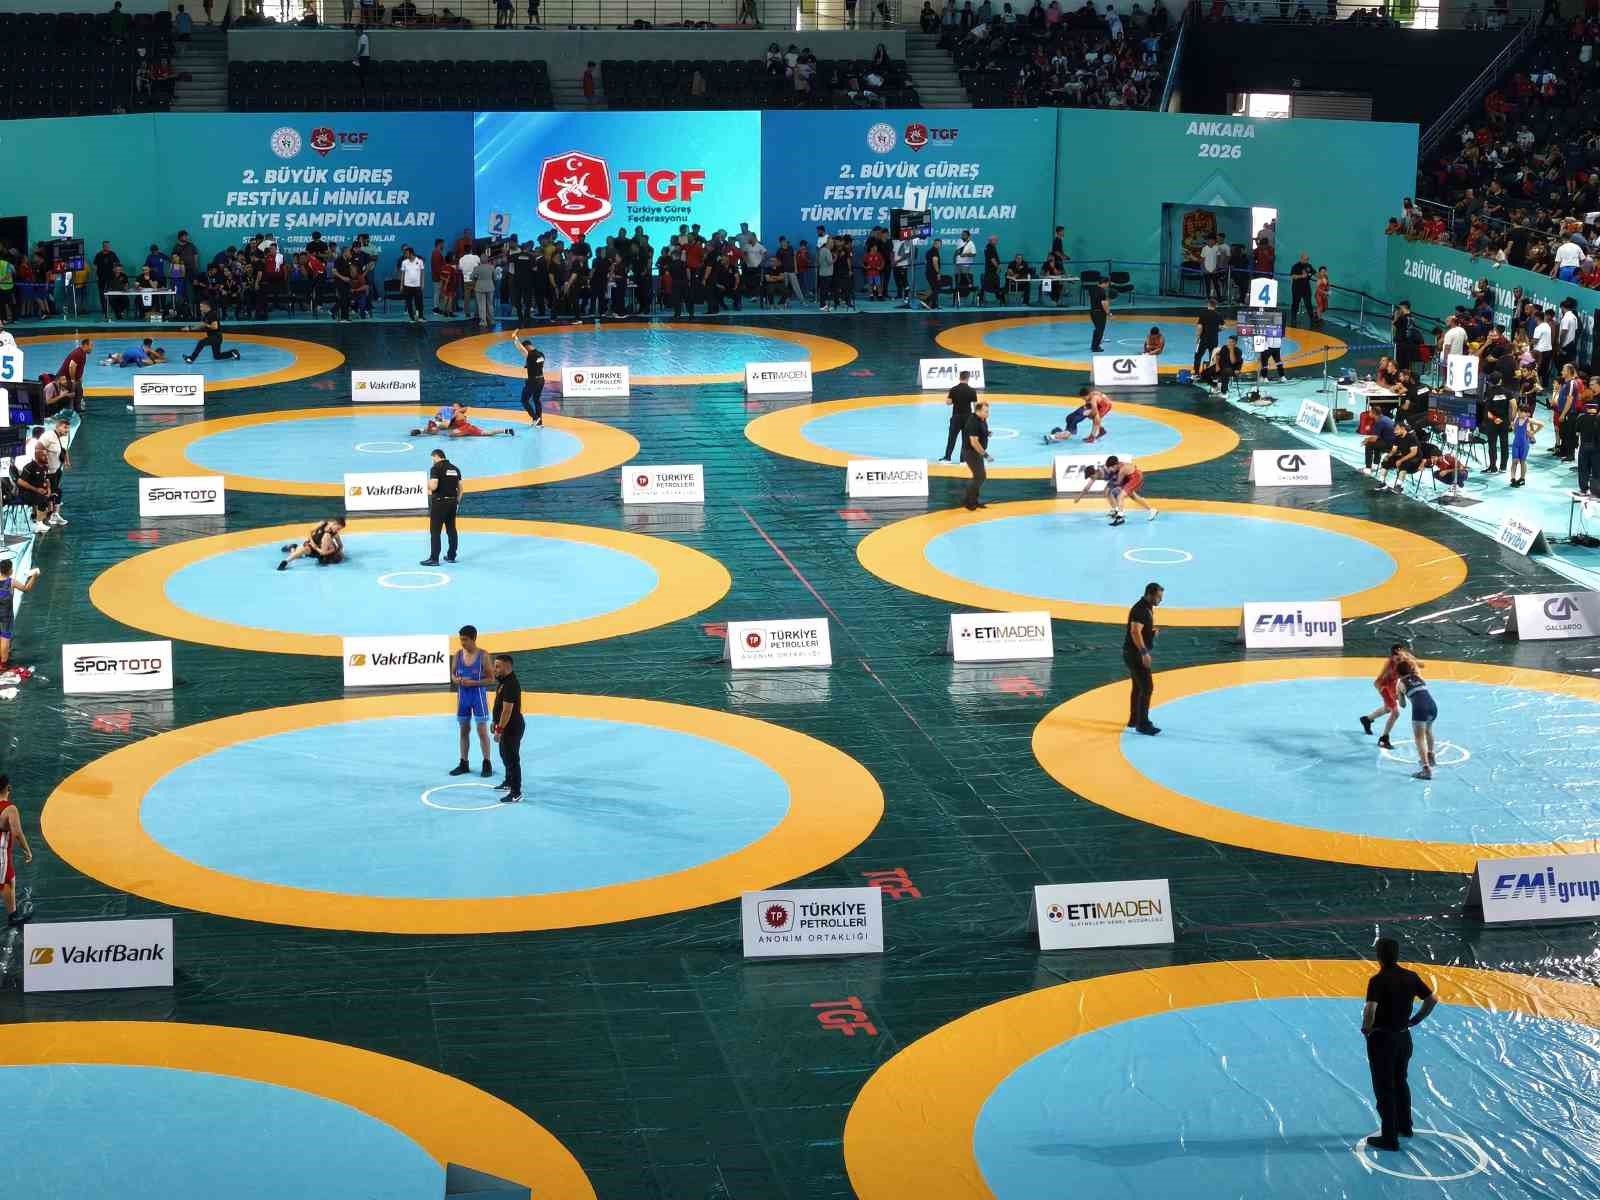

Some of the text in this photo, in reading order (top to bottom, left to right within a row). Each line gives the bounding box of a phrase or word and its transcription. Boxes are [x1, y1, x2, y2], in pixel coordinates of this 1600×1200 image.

[338, 132, 368, 144] TGF
[930, 128, 959, 140] TGF
[1185, 121, 1255, 138] ANKARA
[1198, 143, 1241, 158] 2026
[242, 166, 392, 186] 2. BÜYÜK GÜREŞ
[840, 161, 980, 181] 2. BÜYÜK GÜREŞ
[618, 170, 706, 203] TGF
[226, 188, 410, 206] FESTİVALİ MİNİKLER
[912, 192, 920, 208] 1
[627, 206, 691, 215] Türkiye Güreş
[800, 204, 874, 221] TÜRKİYE
[58, 216, 67, 234] 3
[202, 209, 436, 230] TÜRKİYE ŞAMPİYONALARI
[493, 214, 503, 231] 2
[628, 215, 688, 224] Federasyonu
[1404, 259, 1441, 286] 2.BÜYÜK
[1443, 269, 1473, 299] GÜREŞ
[1258, 284, 1270, 305] 4
[1, 355, 14, 380] 5
[1464, 362, 1472, 387] 6
[656, 472, 694, 482] TÜRKİYE
[769, 628, 818, 641] TÜRKİYE
[1305, 620, 1337, 638] grup
[770, 640, 819, 649] PETROLLERİ
[74, 657, 162, 672] SPORTOTO
[371, 650, 445, 667] VakıfBank
[770, 911, 783, 921] TP
[799, 900, 868, 917] TÜRKİYE
[800, 917, 868, 929] PETROLLERİ
[758, 932, 869, 944] ANONİM ORTAKLIĞI
[62, 944, 165, 964] VakıfBank
[809, 996, 878, 1036] TGF
